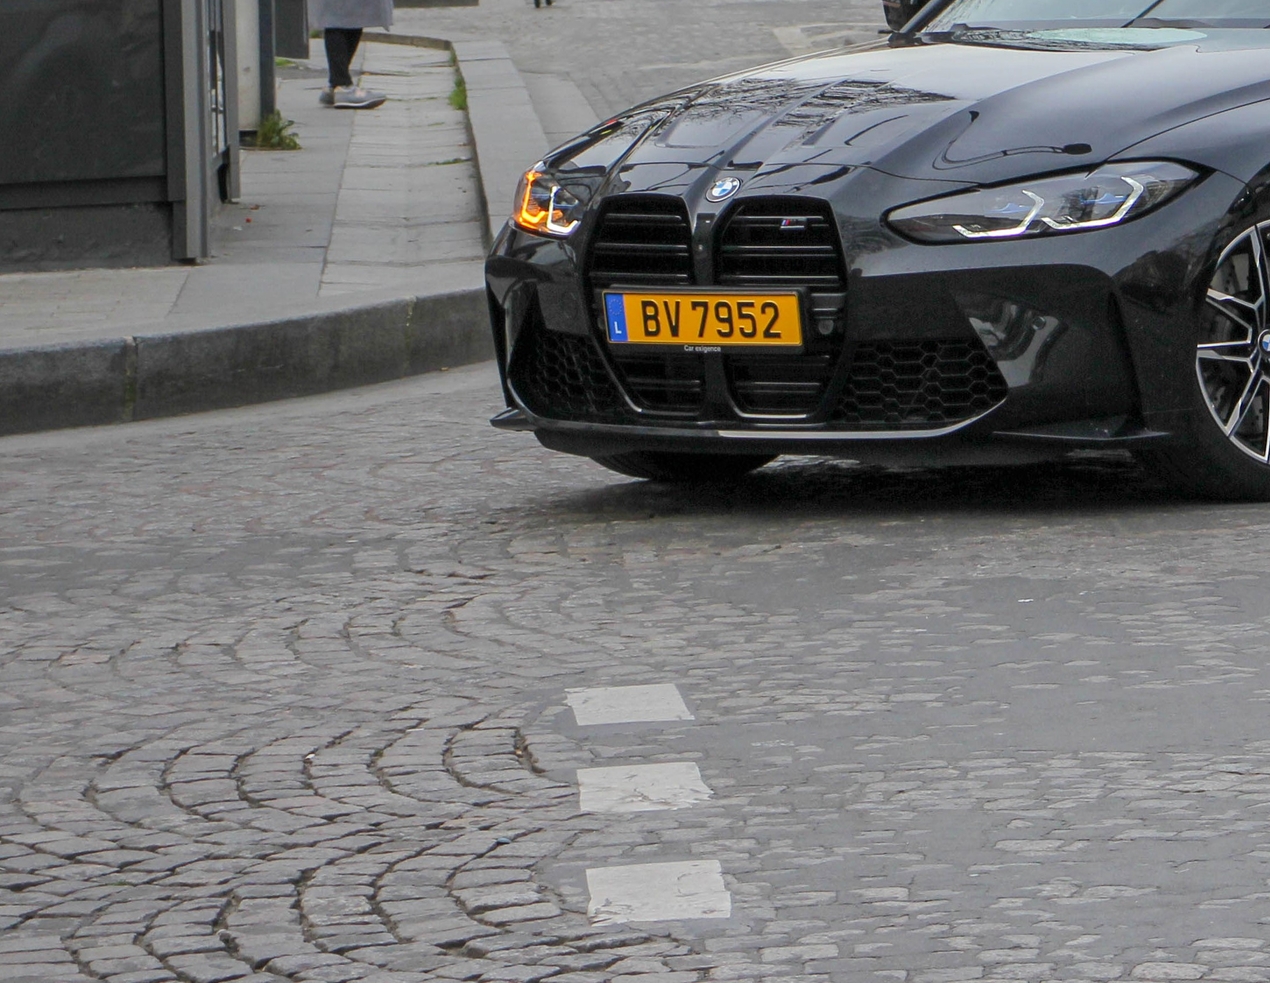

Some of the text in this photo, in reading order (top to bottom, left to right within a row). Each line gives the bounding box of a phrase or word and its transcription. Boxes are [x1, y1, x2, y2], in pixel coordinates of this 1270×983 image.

[640, 299, 782, 339] BV 7952
[614, 321, 622, 334] L
[684, 344, 694, 352] Car
